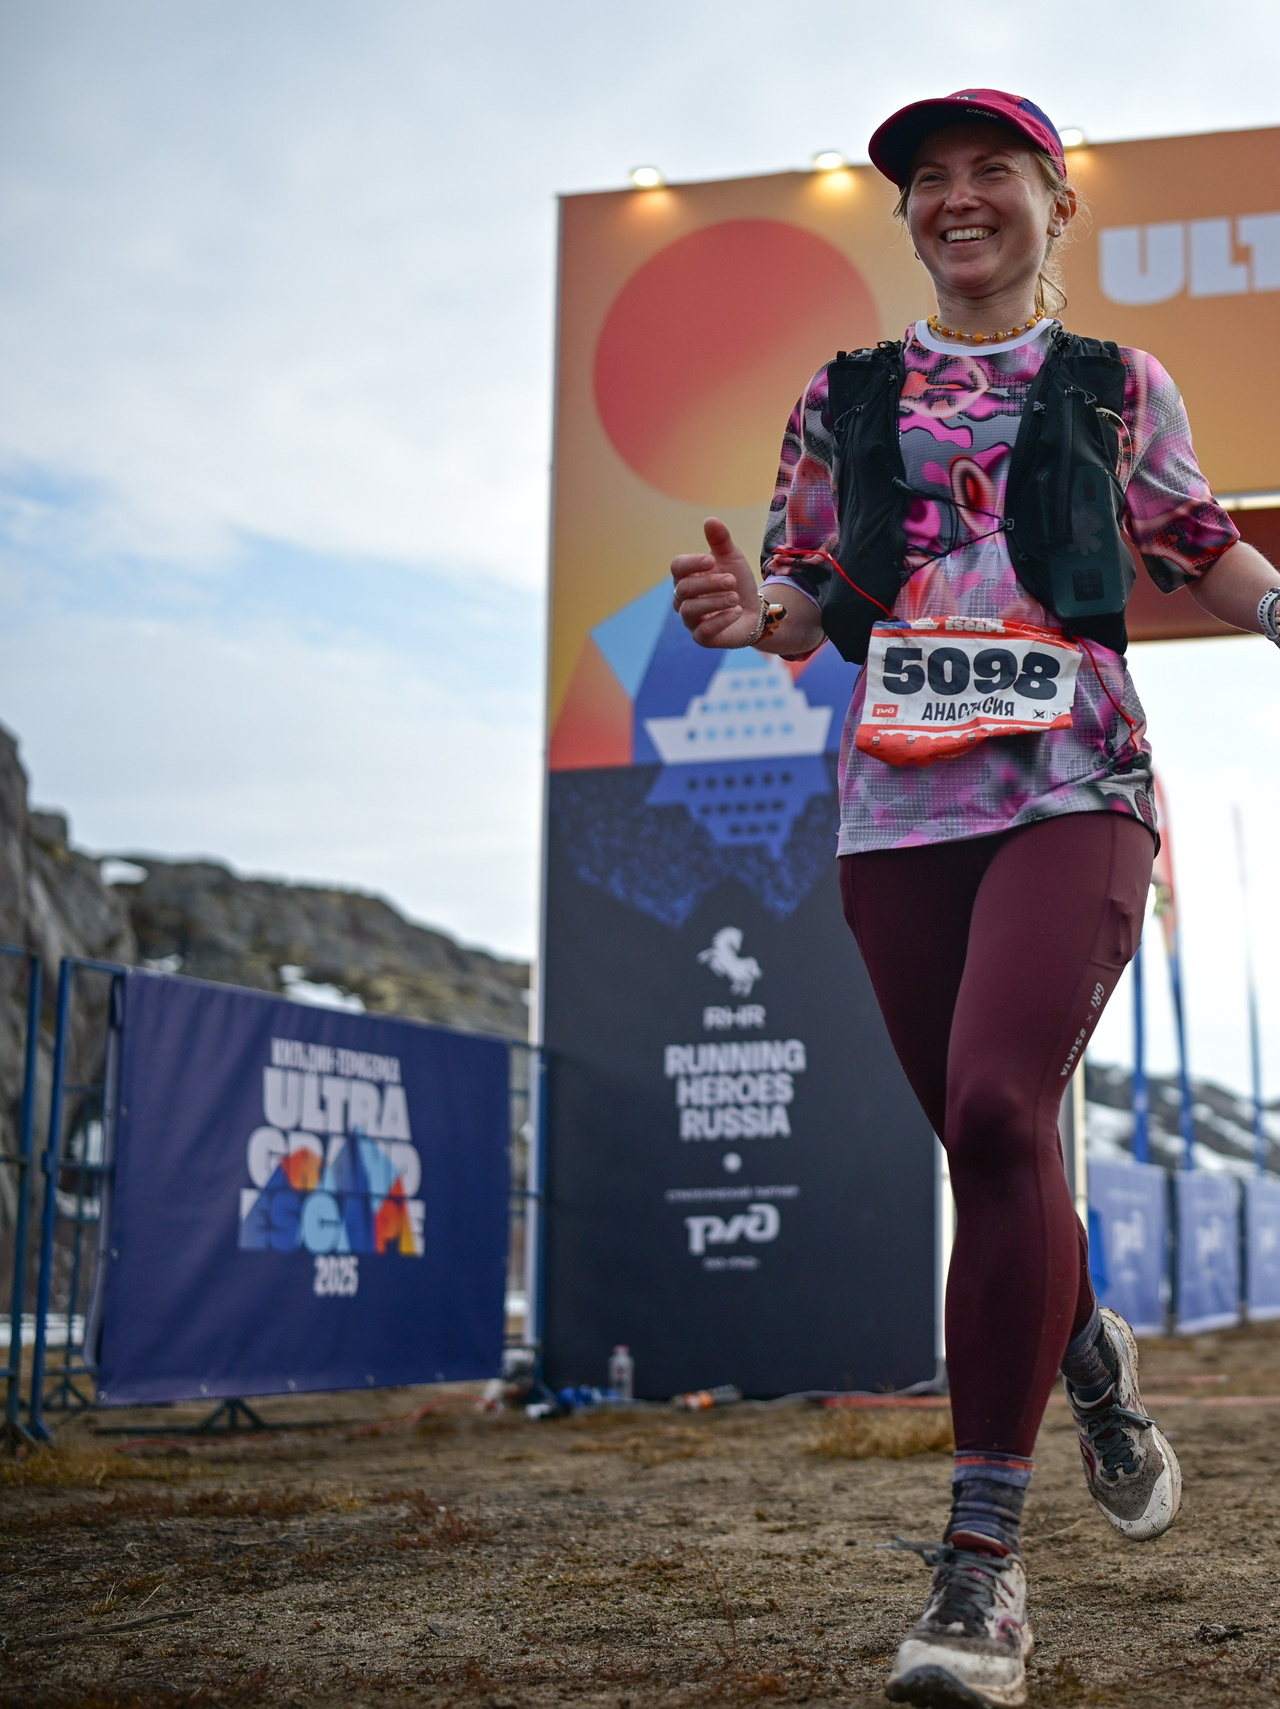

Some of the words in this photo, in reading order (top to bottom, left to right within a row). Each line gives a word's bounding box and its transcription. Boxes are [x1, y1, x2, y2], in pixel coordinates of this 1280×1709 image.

[882, 646, 1061, 700] 5098
[703, 1004, 766, 1030] RHR
[664, 1039, 806, 1078] RUNNING
[263, 1066, 412, 1141] ULTRA
[676, 1072, 795, 1107] HEROES
[680, 1104, 792, 1141] RUSSIA
[246, 1126, 422, 1199] GRAND
[238, 1187, 426, 1258] ESCAPE
[314, 1256, 359, 1296] 2025
